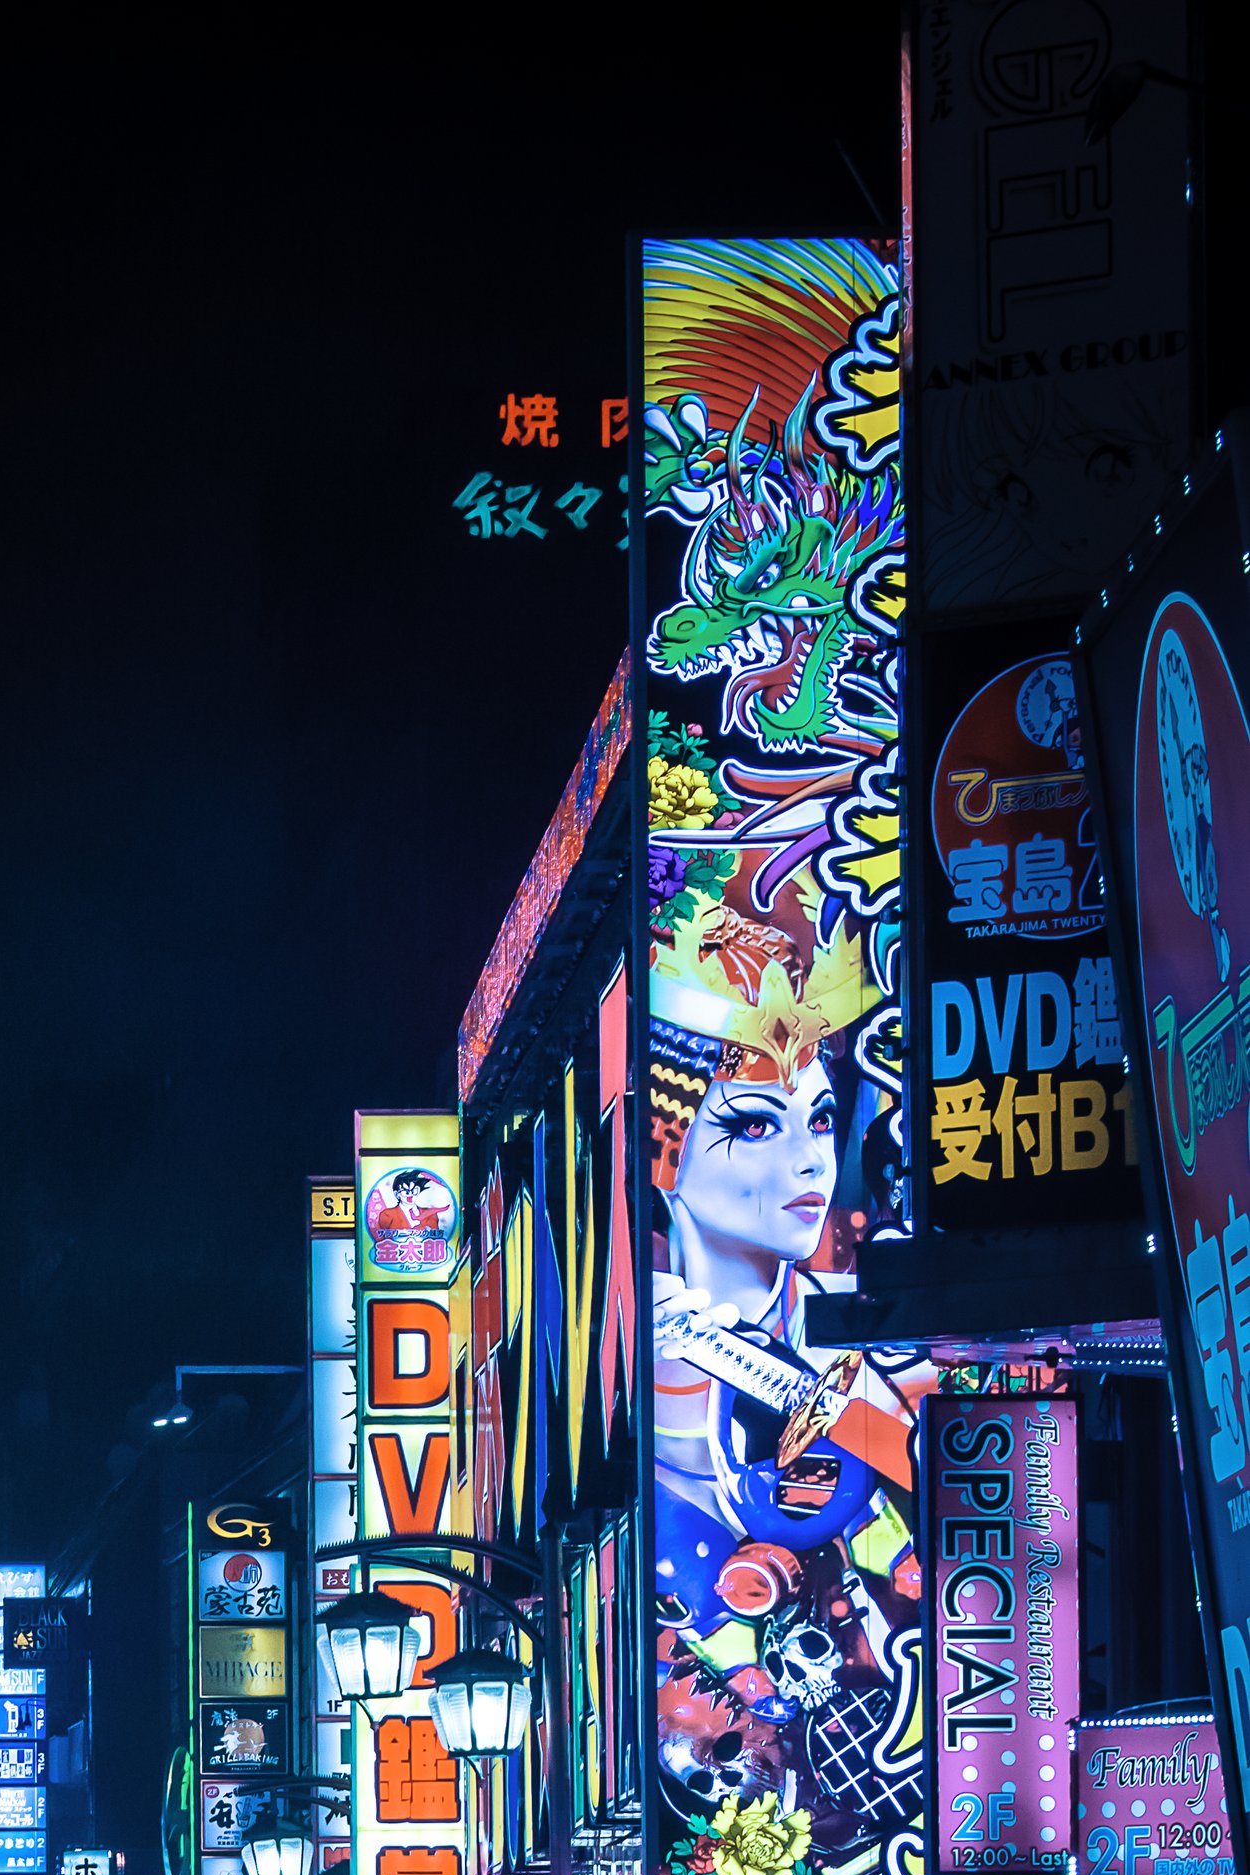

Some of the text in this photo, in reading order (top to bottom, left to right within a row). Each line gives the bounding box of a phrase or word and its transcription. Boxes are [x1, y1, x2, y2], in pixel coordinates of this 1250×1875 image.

[923, 330, 1190, 392] ANNEX GROUP
[452, 471, 627, 552] 叙々
[966, 920, 1049, 940] TAKARAJIMA
[375, 1238, 448, 1264] 金太郎
[941, 1416, 1019, 1751] SPECIAL
[1024, 1414, 1067, 1721] Family Restaurant
[206, 1661, 283, 1679] MIRAGE
[327, 1699, 343, 1713] 1F
[1087, 1731, 1214, 1808] Family
[950, 1792, 1016, 1843] 2F
[1158, 1822, 1222, 1849] 12:00
[951, 1848, 1008, 1869] 12:00
